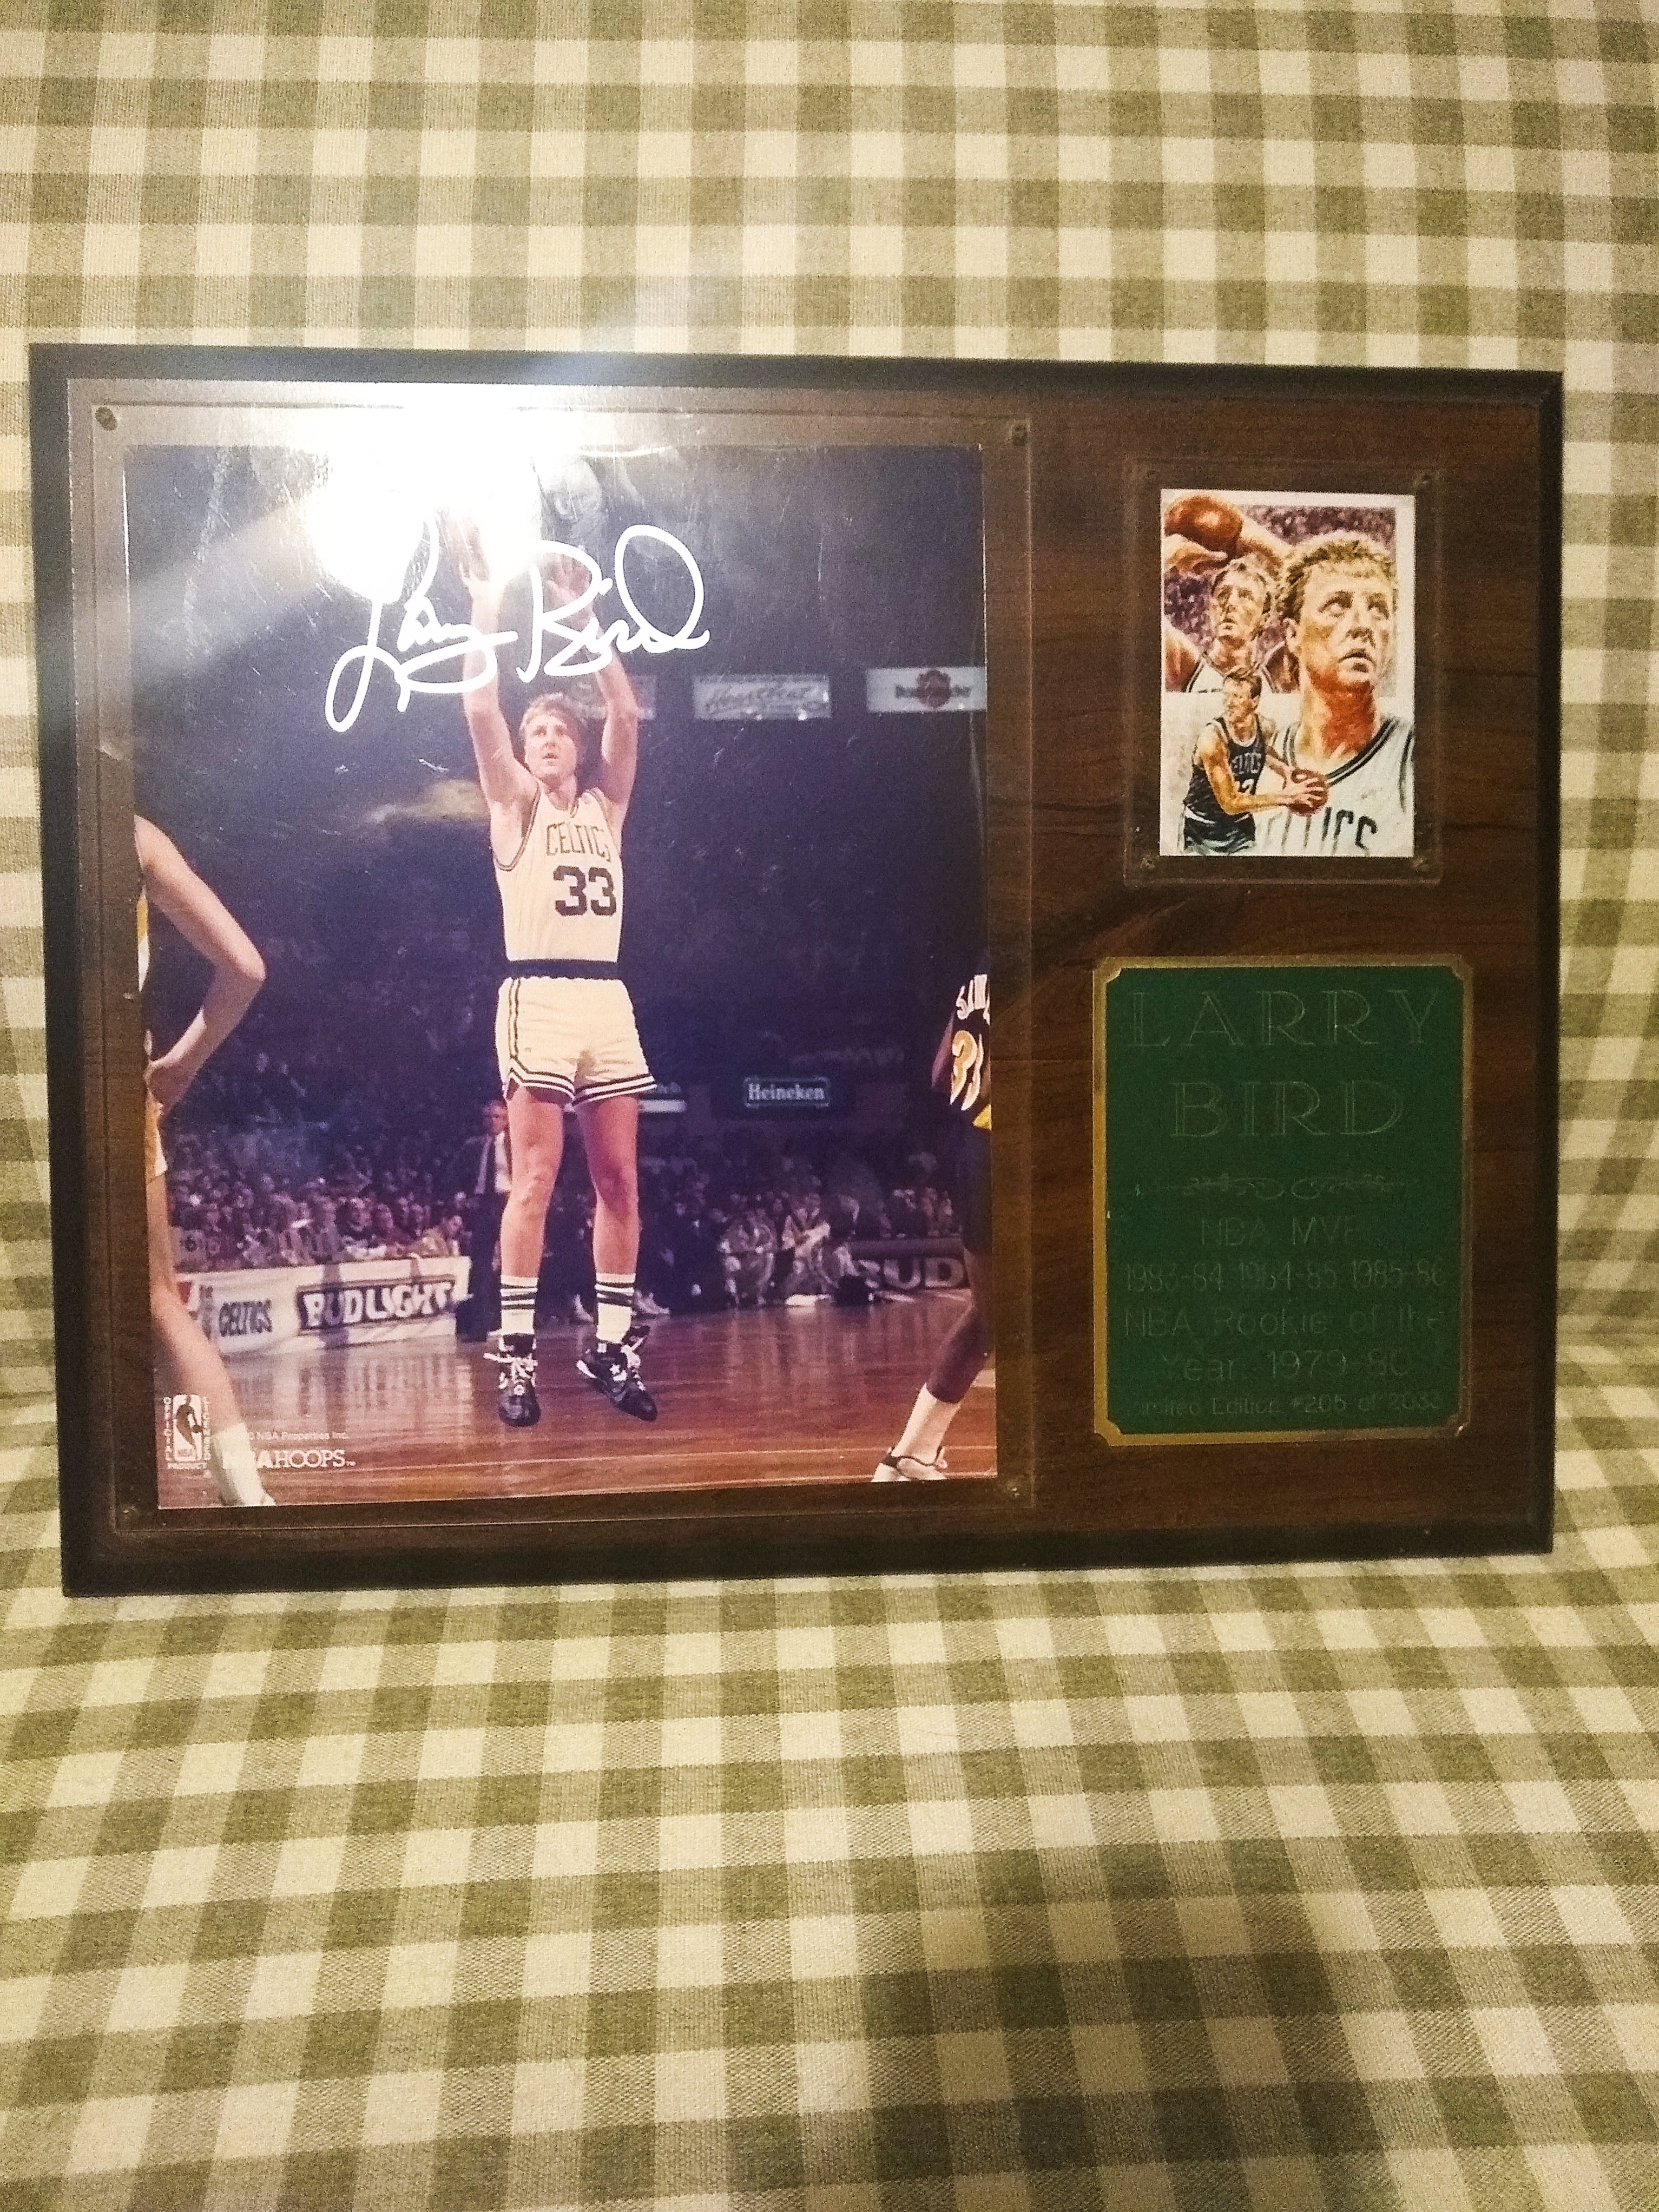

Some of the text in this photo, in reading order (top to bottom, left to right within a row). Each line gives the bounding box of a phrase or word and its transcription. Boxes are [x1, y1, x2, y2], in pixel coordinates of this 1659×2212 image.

[553, 865, 616, 916] 33
[1124, 989, 1440, 1047] LARRY
[749, 1083, 824, 1100] Heineken
[1169, 1081, 1405, 1137] BIRD
[1200, 1216, 1270, 1247] NBA
[1124, 1307, 1194, 1338] NBA
